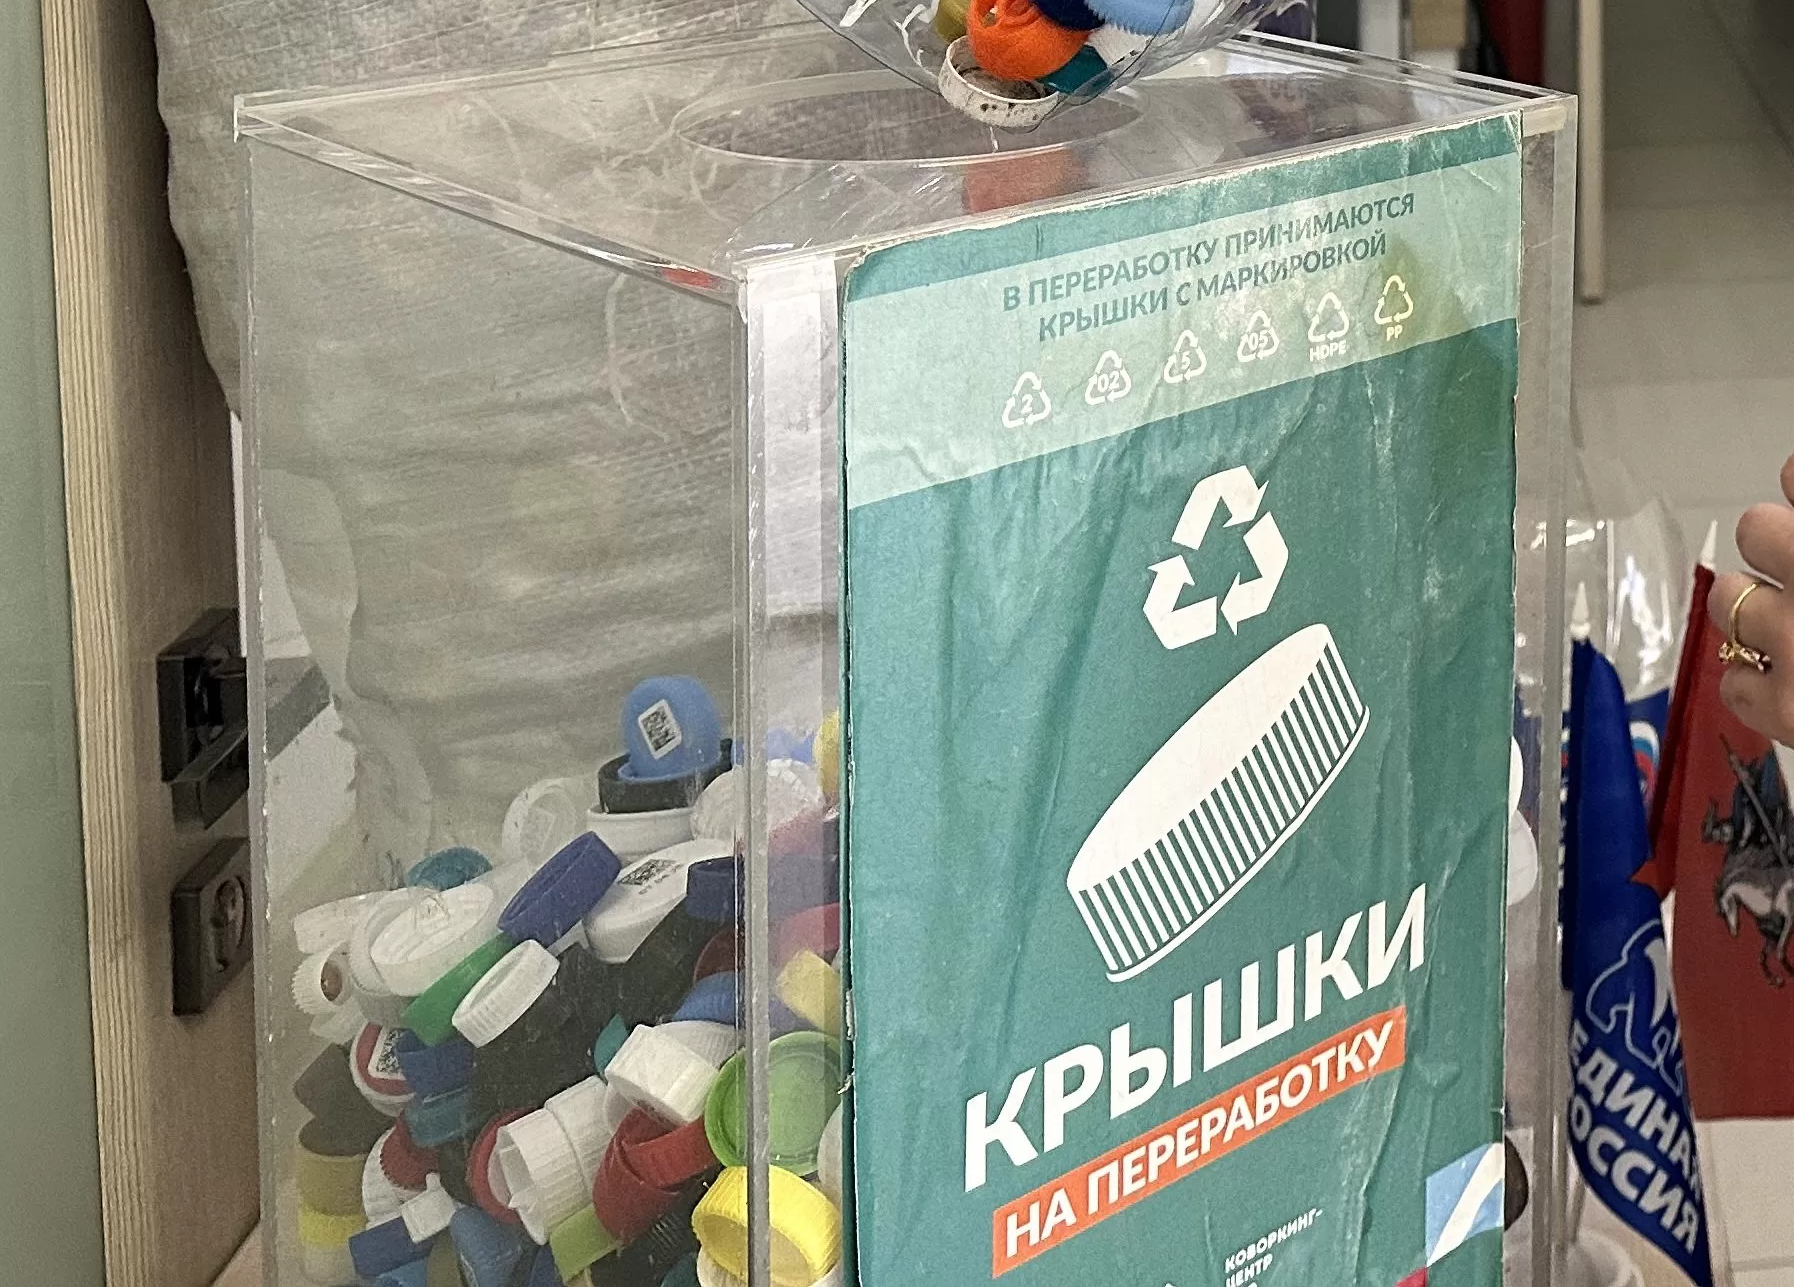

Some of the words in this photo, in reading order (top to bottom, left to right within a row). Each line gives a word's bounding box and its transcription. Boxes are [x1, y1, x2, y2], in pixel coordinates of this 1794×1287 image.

[1003, 286, 1021, 312] В
[1028, 237, 1219, 306] ПЕРЕРАБОТКУ
[1225, 192, 1416, 259] ПРИНИМАЮТСЯ
[1038, 287, 1169, 343] КРЫШКИ
[1175, 281, 1191, 307] С
[1198, 230, 1388, 302] МАРКИРОВКОЙ
[1020, 394, 1034, 414] 2
[1096, 369, 1122, 392] 02
[1179, 351, 1191, 370] 5
[1247, 330, 1269, 351] 05
[1309, 341, 1348, 363] HDPE
[1386, 325, 1403, 342] PP
[963, 882, 1427, 1194] КРЫШКИ
[1004, 1189, 1077, 1259] НА
[1087, 1018, 1395, 1220] ПЕРЕРАБОТКУ
[1569, 1094, 1700, 1254] ОССИЯ
[1225, 1207, 1323, 1274] КОВОРКИНГ-
[1225, 1253, 1274, 1287] ЦЕНТР
